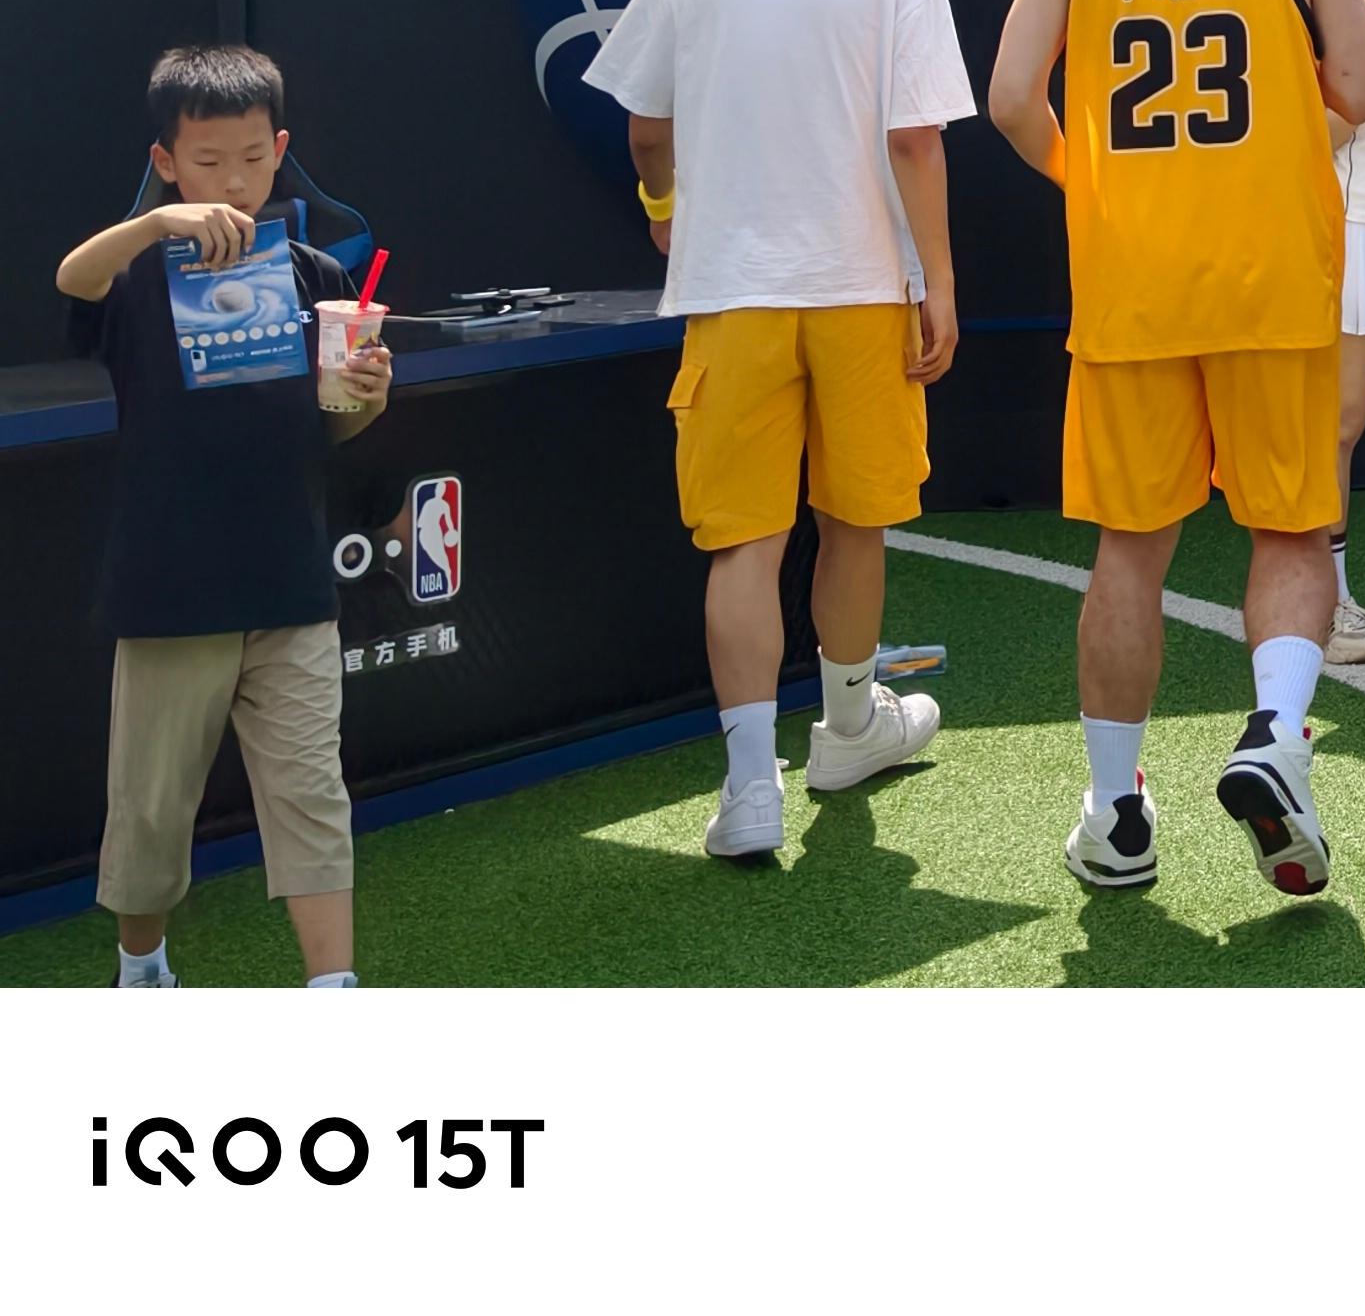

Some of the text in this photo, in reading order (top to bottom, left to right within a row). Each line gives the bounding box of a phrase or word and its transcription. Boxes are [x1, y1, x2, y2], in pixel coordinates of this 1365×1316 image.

[1108, 10, 1253, 154] 23
[420, 571, 444, 595] NBA
[343, 626, 460, 673] 官方手机
